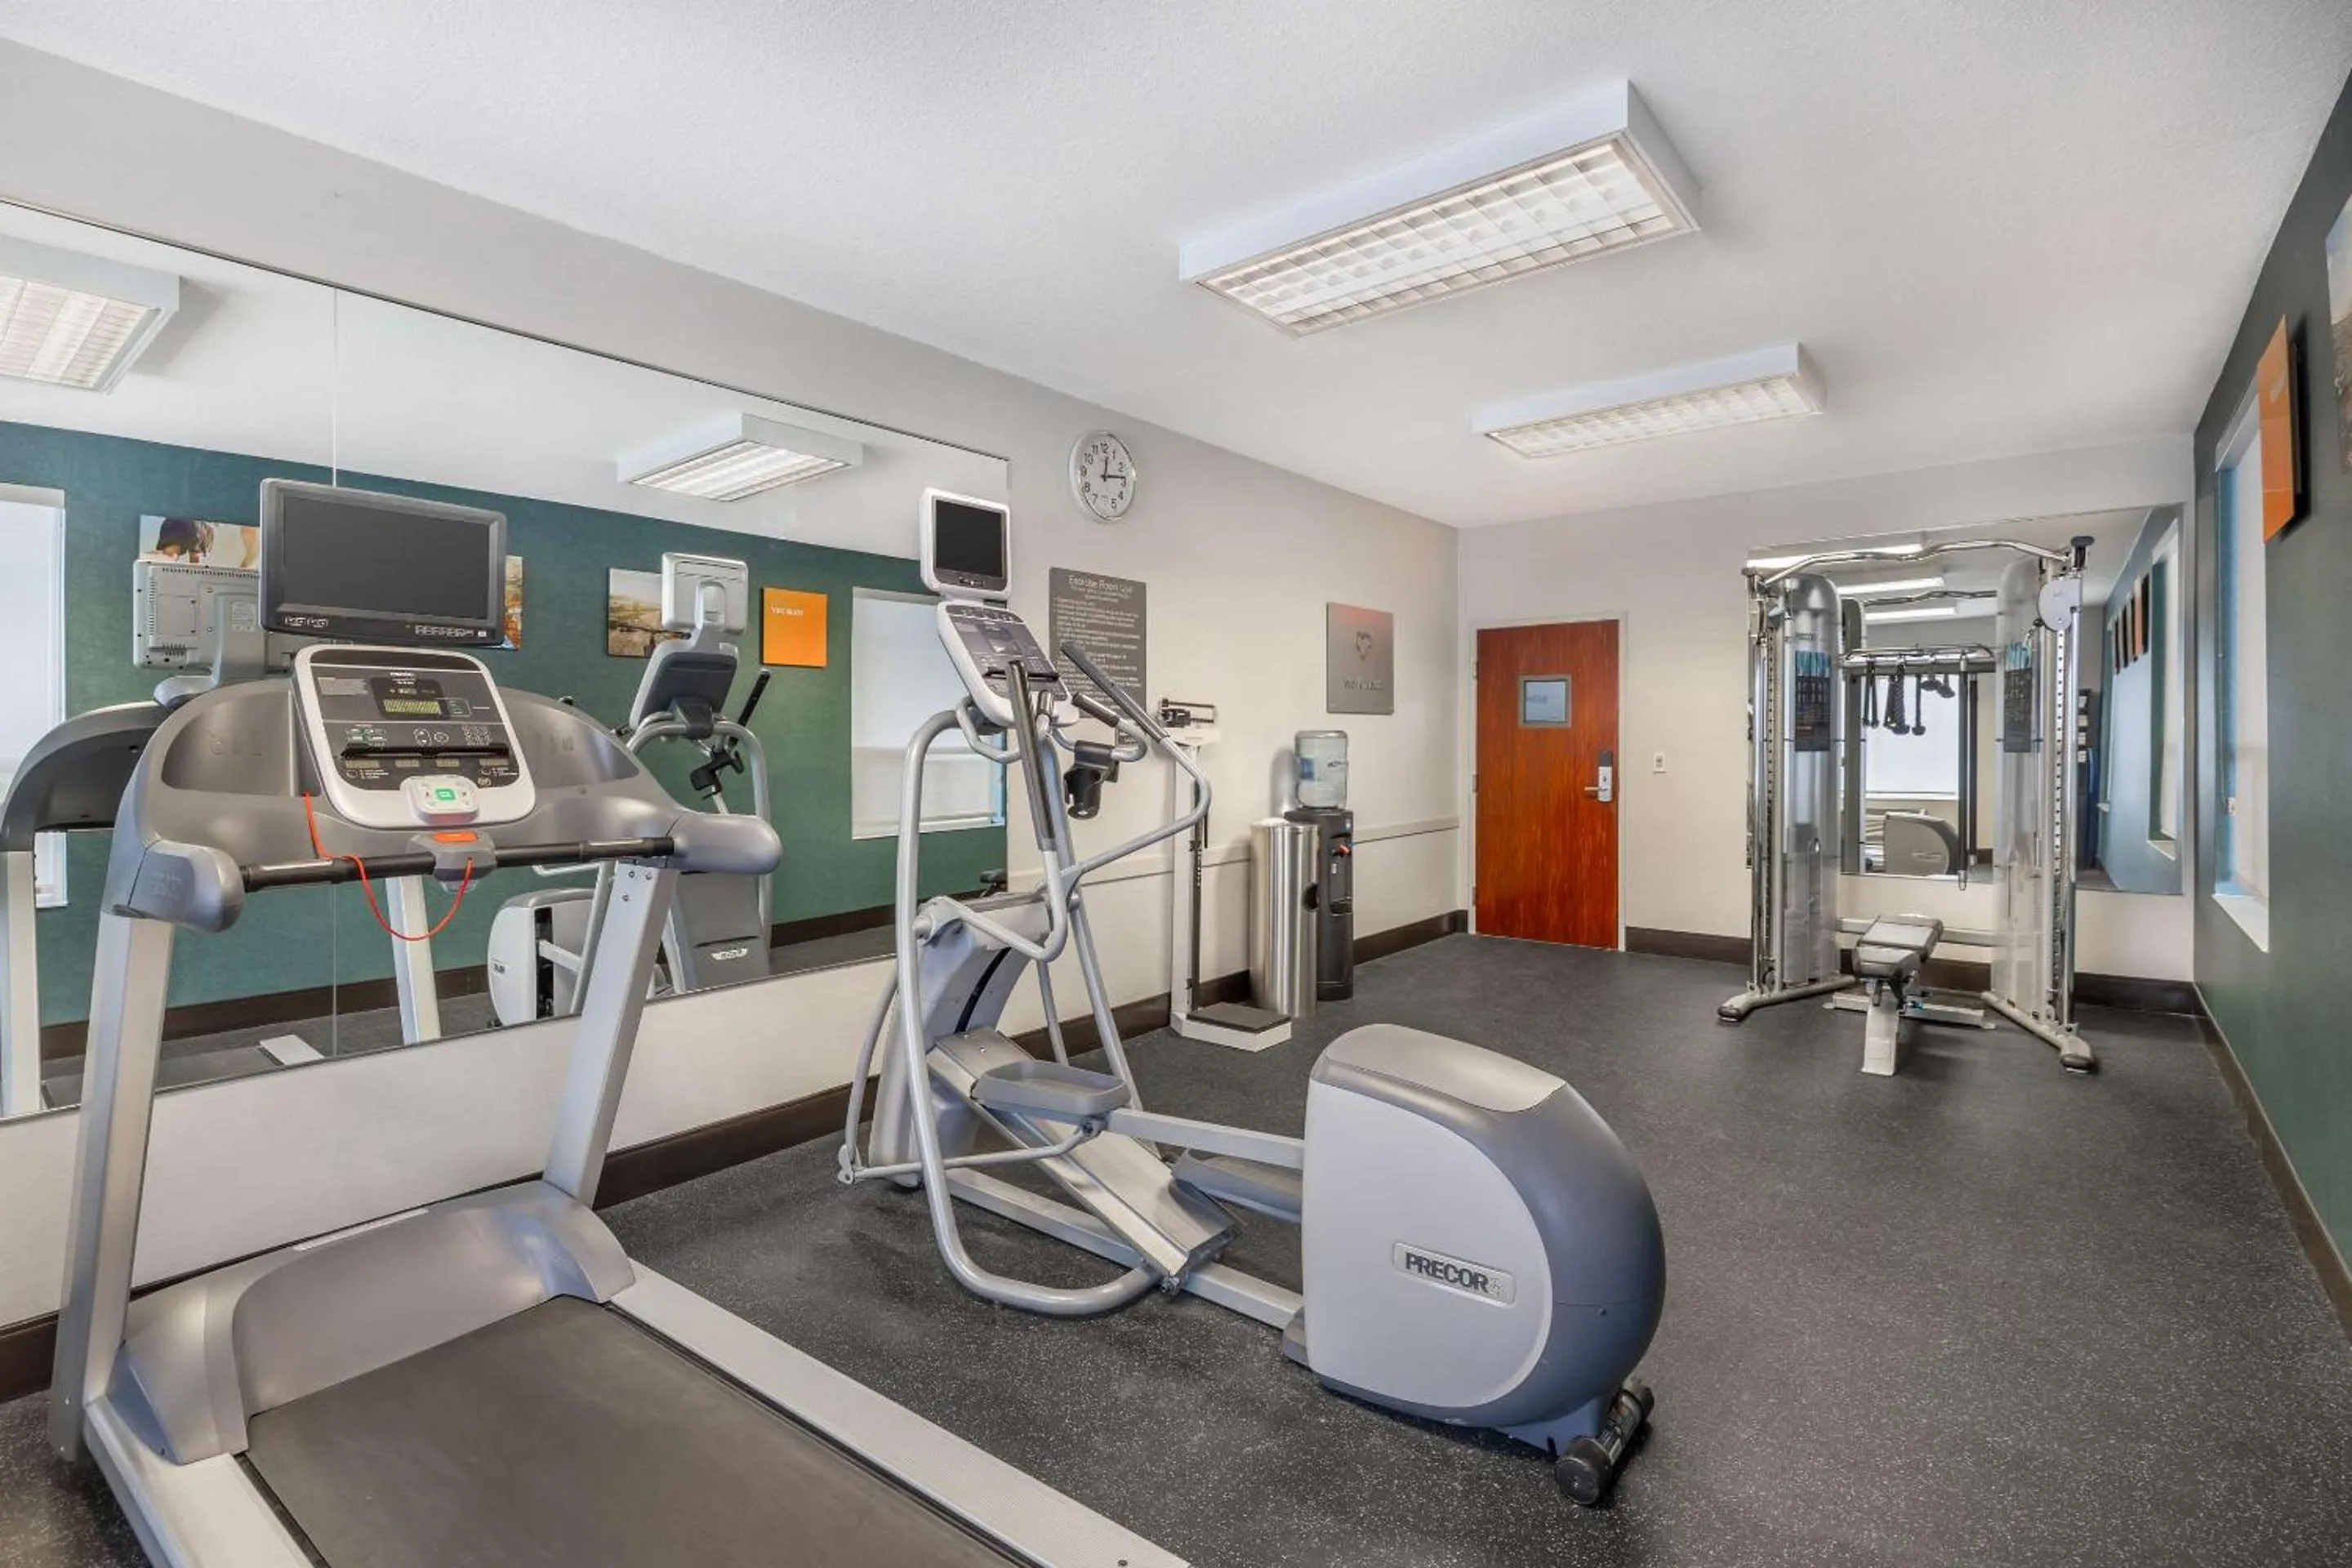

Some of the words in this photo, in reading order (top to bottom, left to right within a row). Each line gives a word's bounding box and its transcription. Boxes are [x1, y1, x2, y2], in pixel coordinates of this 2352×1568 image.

[1091, 444, 1098, 455] 11
[1100, 442, 1109, 454] 12
[1084, 452, 1094, 465] 10
[1080, 465, 1087, 477] 9
[1118, 461, 1125, 473] 2
[1085, 481, 1091, 492] 8
[1120, 476, 1127, 488] 3
[1091, 492, 1098, 504] 7
[1117, 490, 1124, 501] 4
[1111, 497, 1117, 509] 5
[1405, 1251, 1489, 1294] PRECOR
